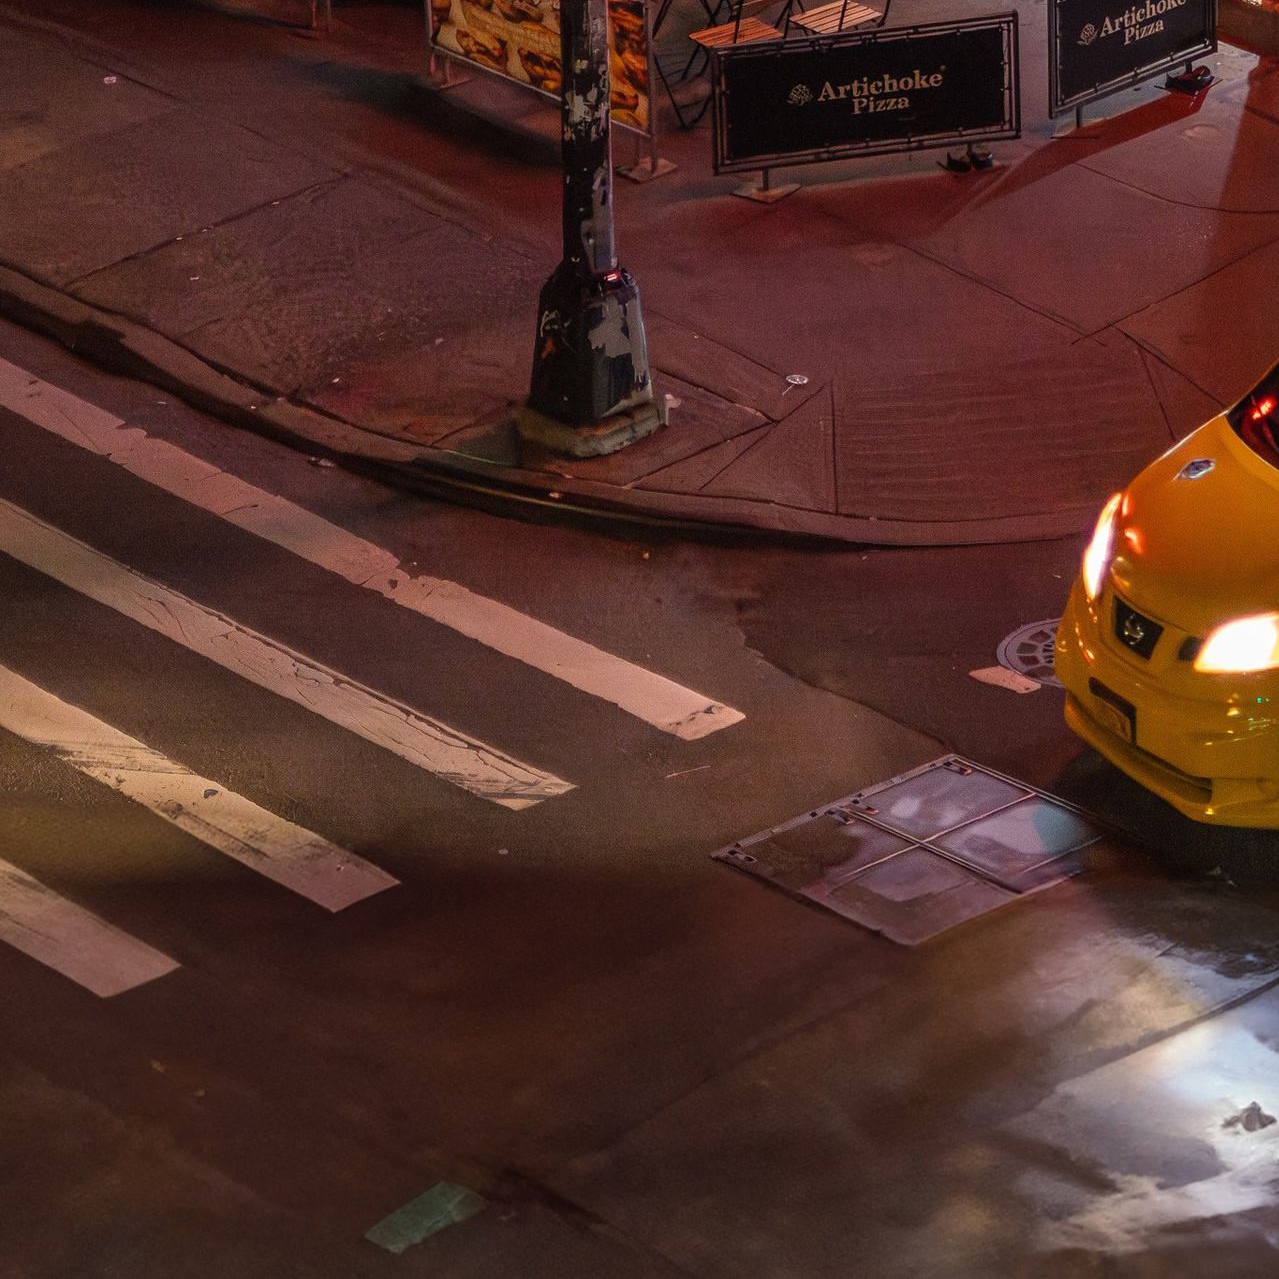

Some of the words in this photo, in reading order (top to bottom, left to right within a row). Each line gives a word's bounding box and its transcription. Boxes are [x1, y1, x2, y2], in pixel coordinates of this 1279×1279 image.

[1123, 19, 1165, 46] Pizza
[817, 70, 943, 102] Artichoke
[851, 96, 911, 115] Pizza
